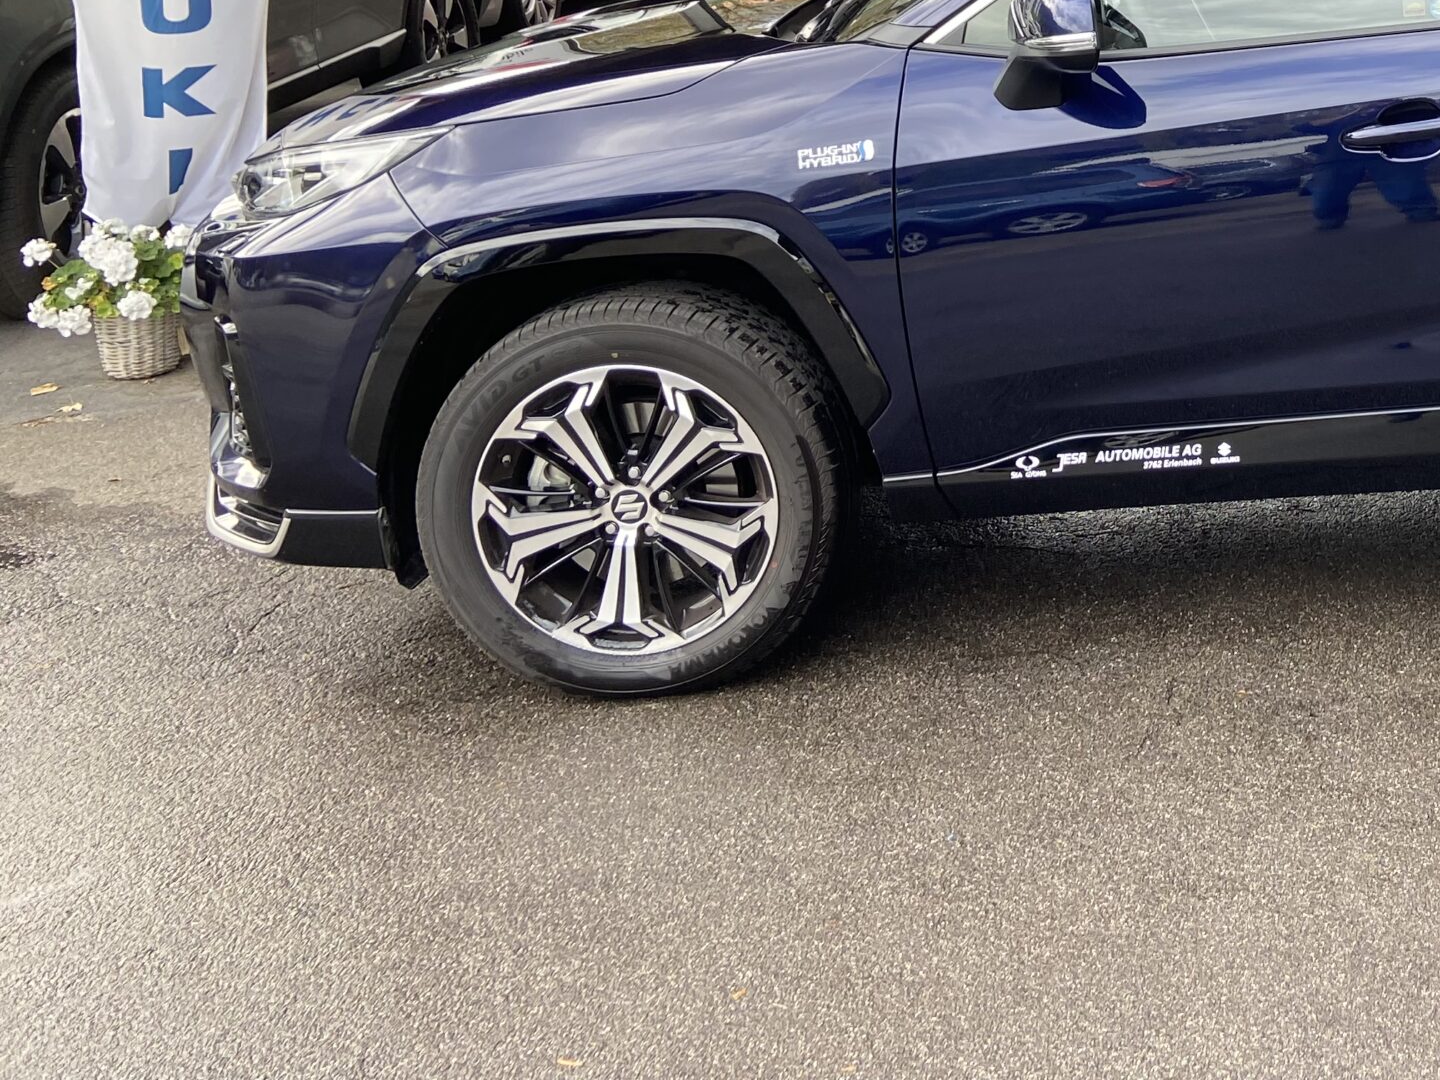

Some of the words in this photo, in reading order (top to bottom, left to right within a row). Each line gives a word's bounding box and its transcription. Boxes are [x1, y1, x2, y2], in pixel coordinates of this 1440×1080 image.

[797, 142, 859, 159] PLUG-IN
[797, 153, 857, 170] HYBRID
[1052, 452, 1087, 473] JESA
[1095, 444, 1181, 463] AUTOMOBILE
[1182, 443, 1202, 457] AG
